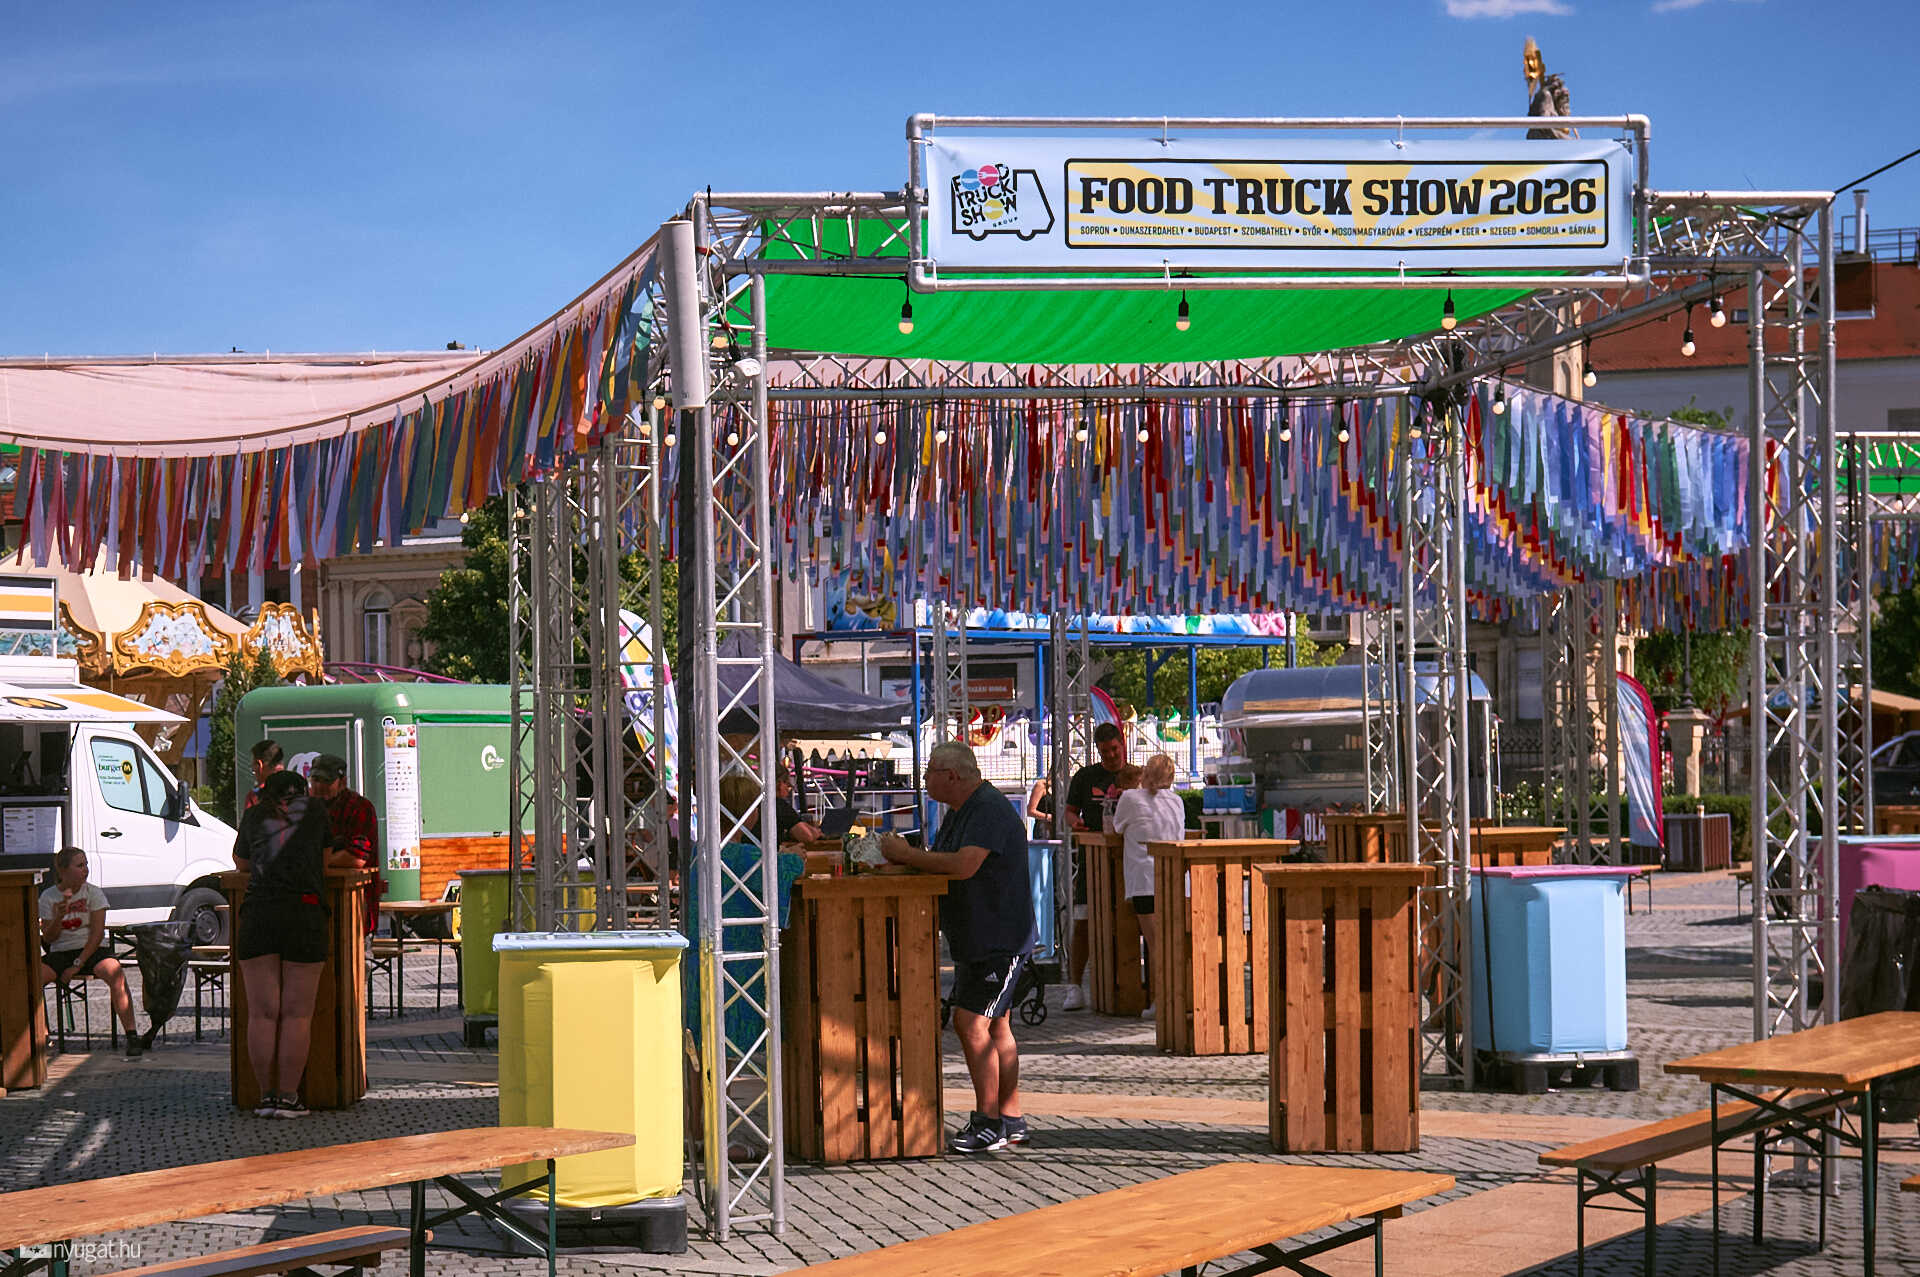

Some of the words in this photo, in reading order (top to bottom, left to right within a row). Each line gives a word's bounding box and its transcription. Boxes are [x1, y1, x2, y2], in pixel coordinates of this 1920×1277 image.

[956, 178, 1016, 209] TRUCK
[1079, 177, 1194, 214] FOOD
[1203, 178, 1352, 215] TRUCK
[1362, 178, 1484, 215] SHOW
[1489, 178, 1597, 215] 2026
[1080, 226, 1110, 235] SOPRON
[1120, 226, 1185, 235] DUNASZERDAHELY
[1194, 226, 1232, 236] BUDAPEST
[1241, 226, 1293, 236] SZOMBATHELY
[1331, 225, 1405, 237] MOSONMAGYARÓVÁR
[1415, 225, 1452, 236] VESZPRÉM
[1462, 226, 1480, 236] EGER
[1490, 226, 1517, 236] SZEGED
[1526, 226, 1559, 235] SOMORJA
[1569, 224, 1597, 235] SÁRVÁR
